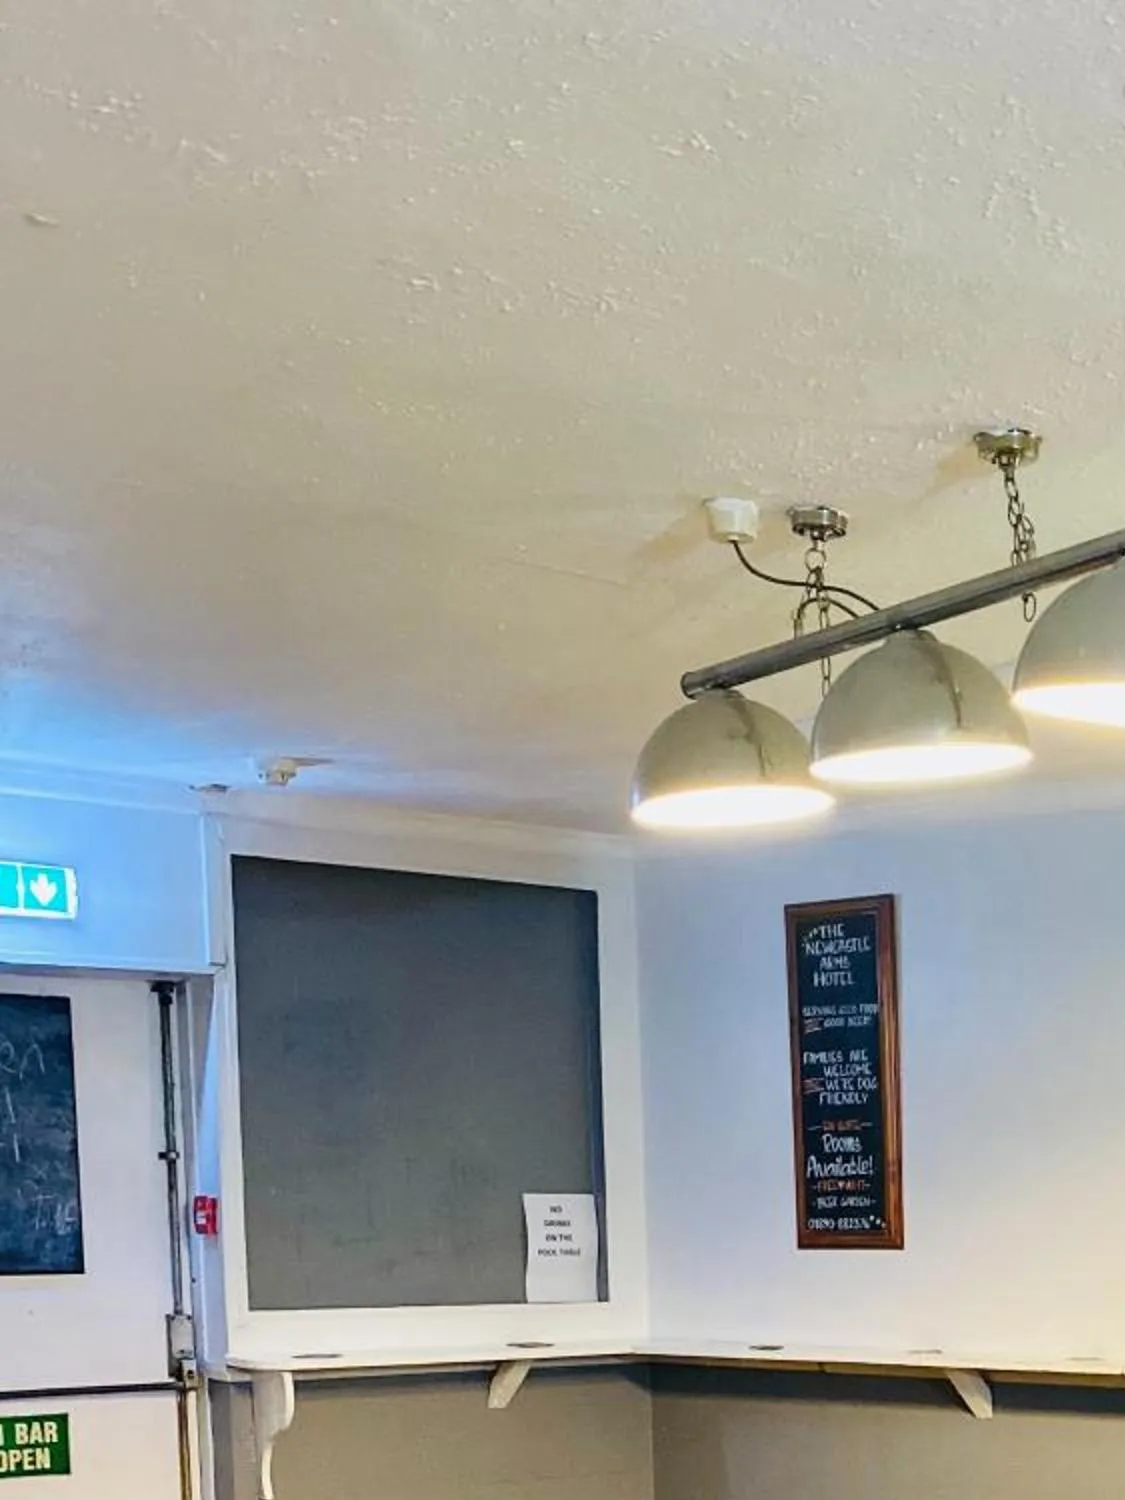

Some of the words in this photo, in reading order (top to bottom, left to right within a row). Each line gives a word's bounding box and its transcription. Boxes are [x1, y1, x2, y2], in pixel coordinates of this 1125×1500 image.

[818, 923, 845, 938] THE
[806, 935, 871, 955] NEWCASTLE
[819, 955, 851, 970] ARMS
[813, 971, 855, 988] HOTEL
[804, 1050, 844, 1065] FAMILIES
[849, 1049, 868, 1062] ARE
[824, 1063, 872, 1077] WELCOME
[857, 1076, 878, 1090] DOG
[820, 1091, 868, 1105] FRIENDLY
[806, 1155, 874, 1178] Available!
[559, 1233, 573, 1241] THE
[538, 1248, 557, 1256] POOL
[560, 1247, 581, 1257] TABLE
[15, 1421, 58, 1444] BAR
[0, 1447, 51, 1472] OPEN
